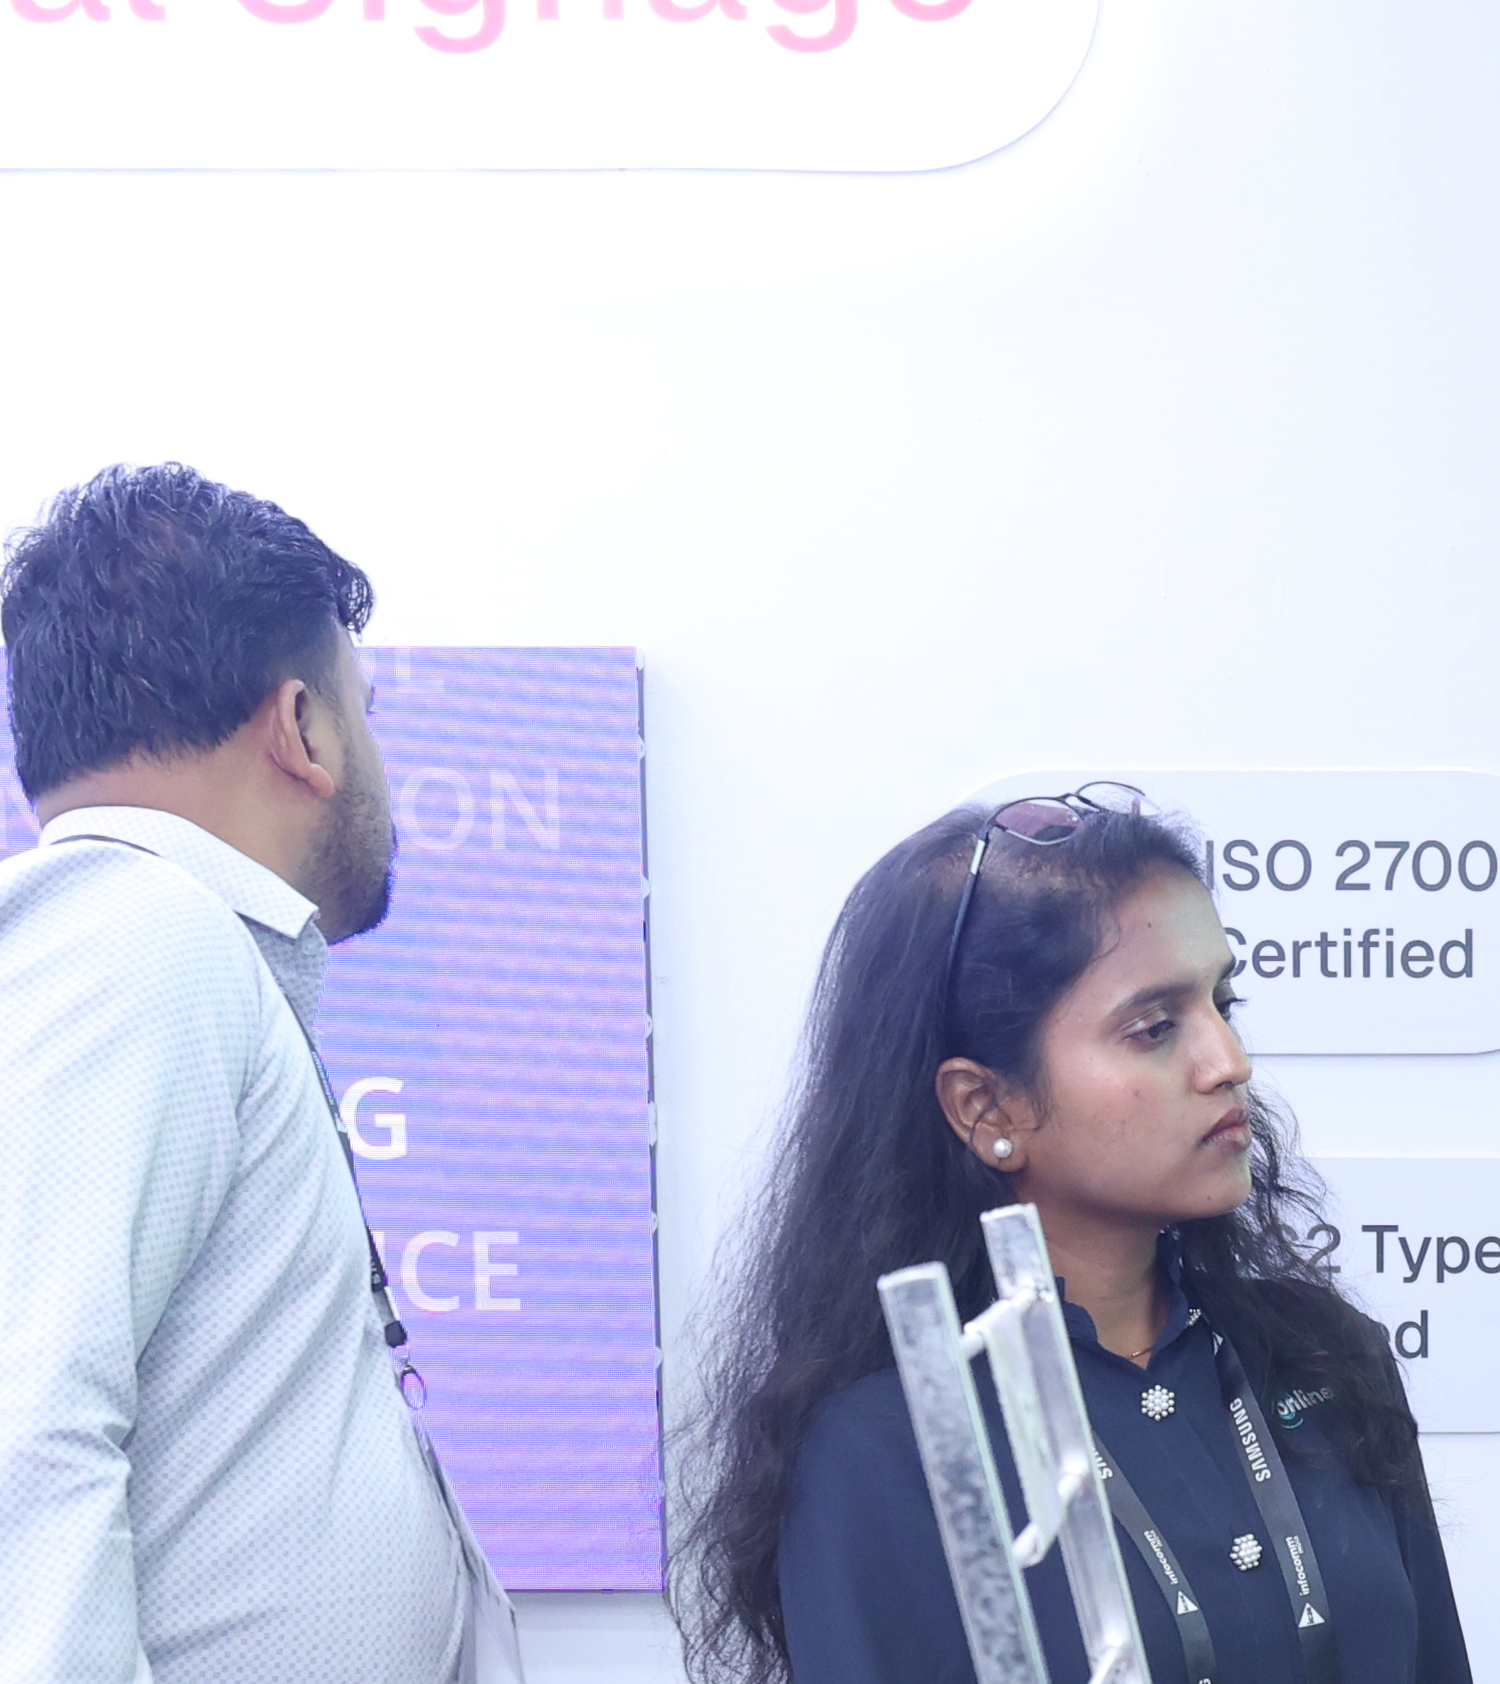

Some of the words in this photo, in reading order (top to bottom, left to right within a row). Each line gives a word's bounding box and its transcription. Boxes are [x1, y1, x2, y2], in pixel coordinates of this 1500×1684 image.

[1205, 838, 1313, 893] ISO
[1229, 1397, 1272, 1482] SAMSUNG
[1144, 1529, 1179, 1586] infocomm
[1285, 1537, 1310, 1597] infocomm
